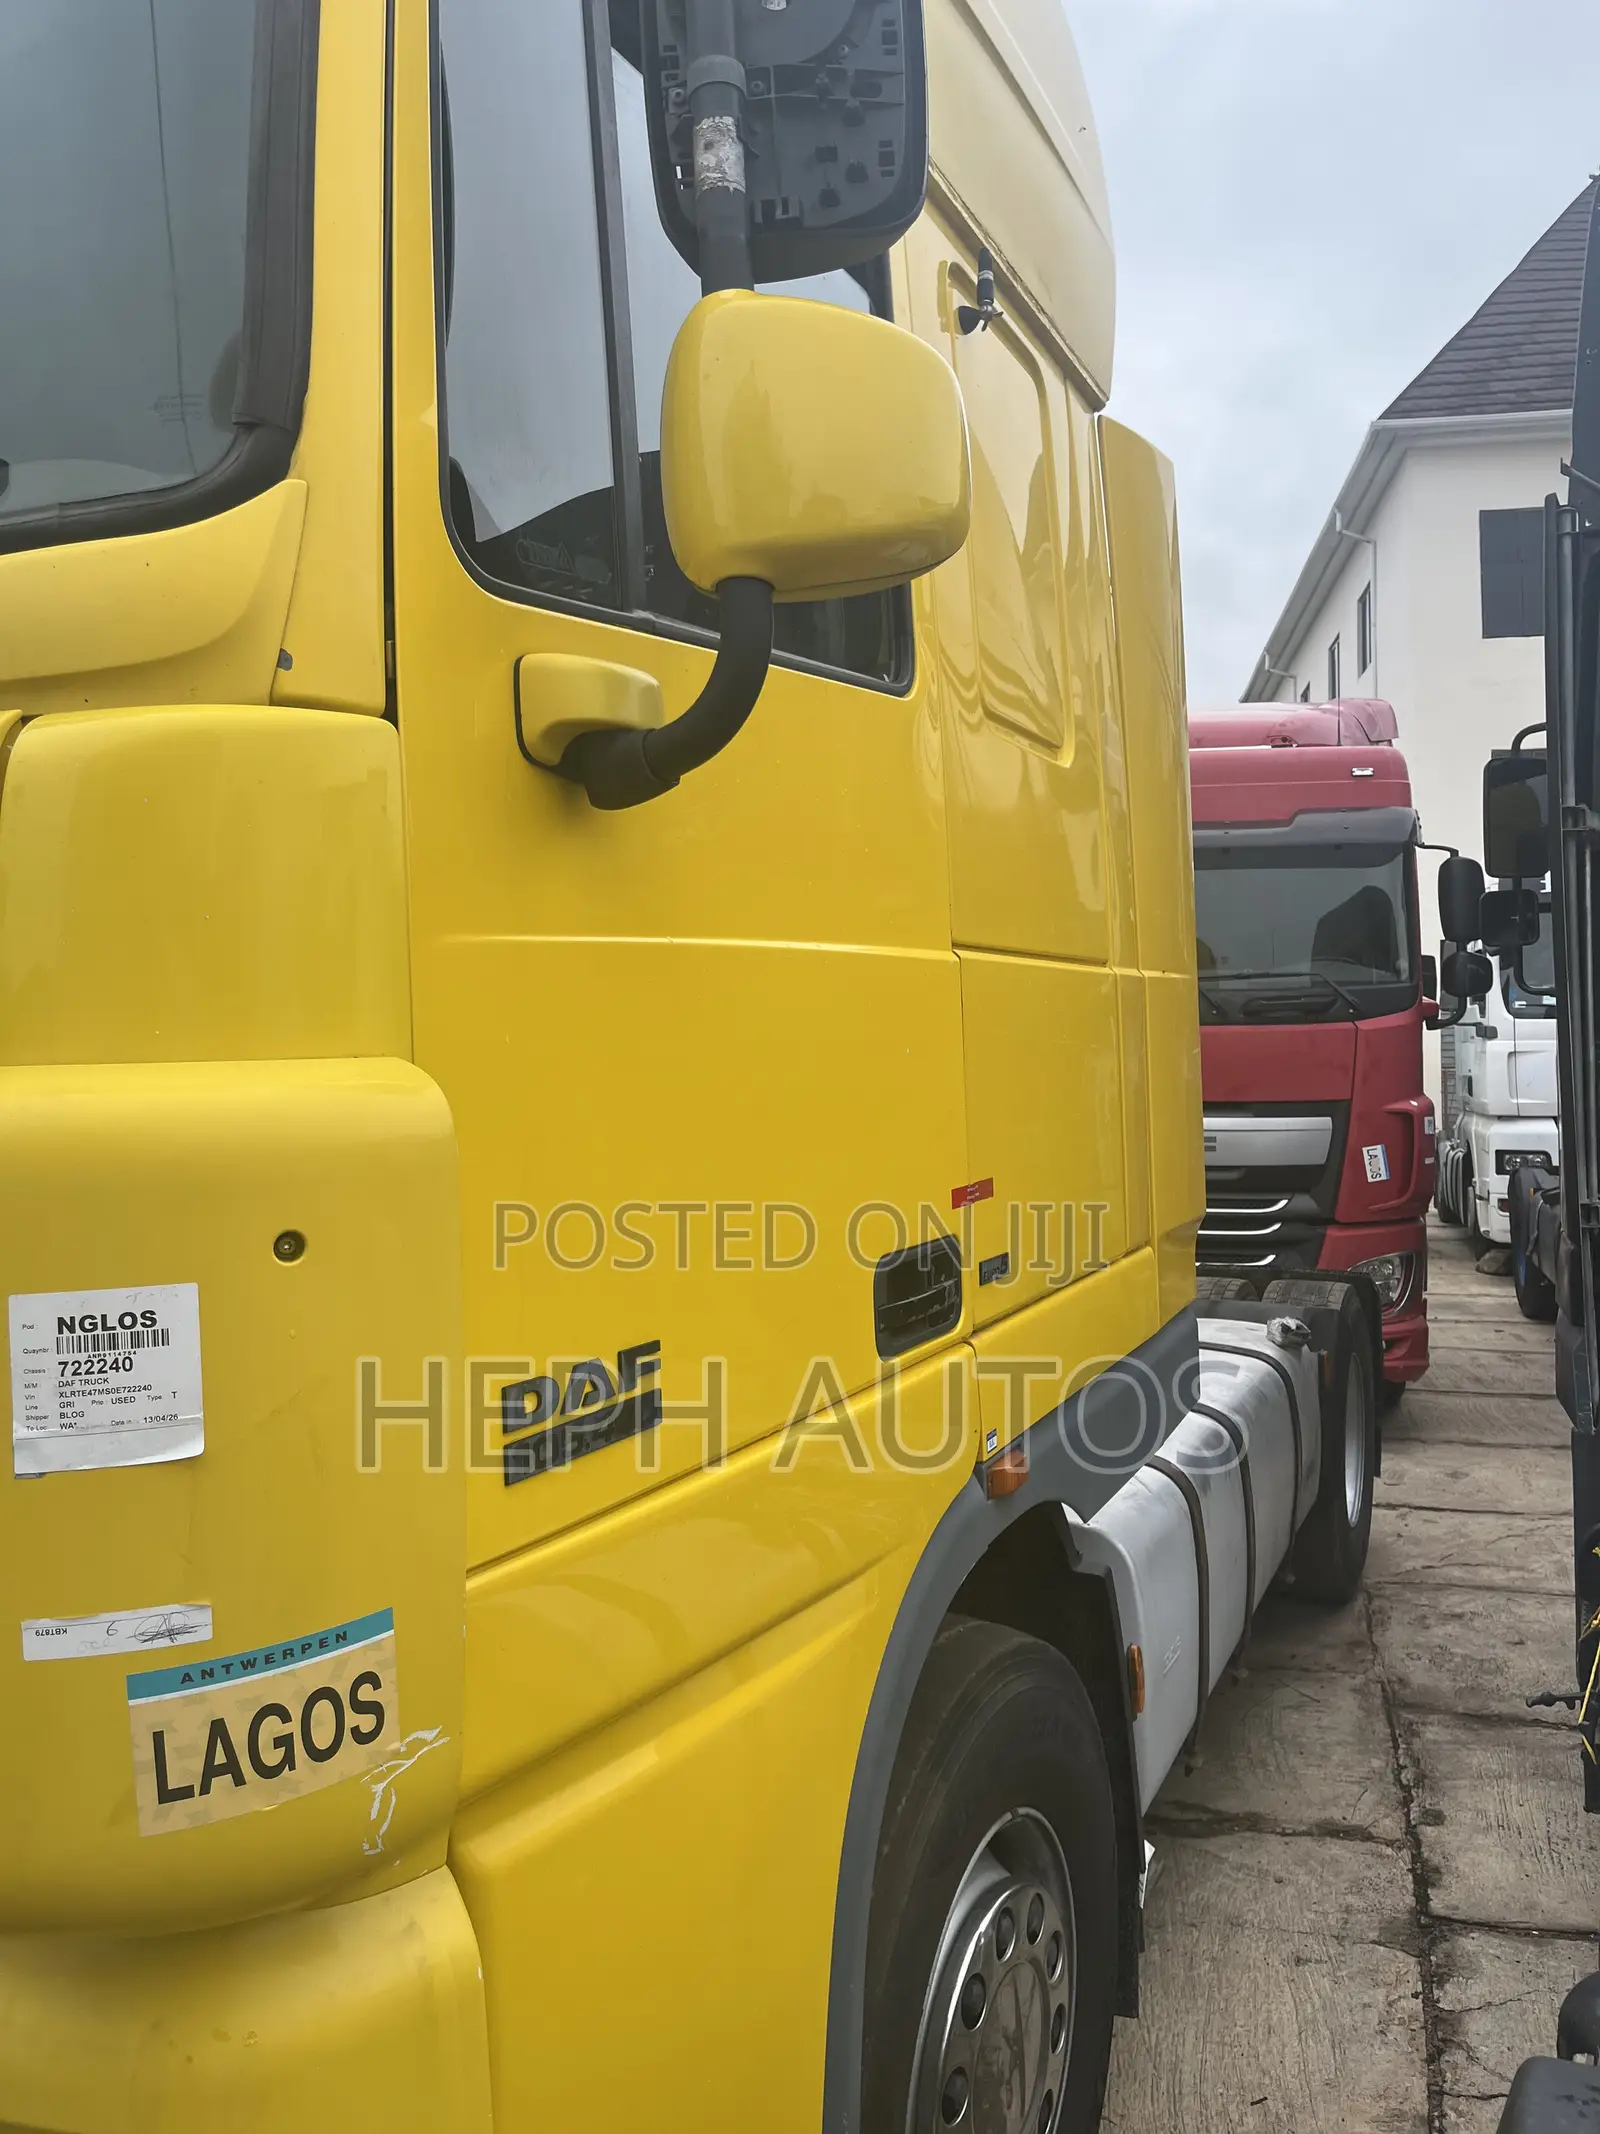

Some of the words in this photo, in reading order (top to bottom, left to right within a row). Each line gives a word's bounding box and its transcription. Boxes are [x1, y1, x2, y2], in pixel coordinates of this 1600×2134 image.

[56, 1309, 158, 1335] NGLOS
[57, 1356, 134, 1378] 722240
[58, 1379, 77, 1388] DAF
[78, 1377, 110, 1387] TRUCK
[501, 1339, 662, 1434] DAF
[59, 1400, 75, 1409] GRI
[110, 1396, 136, 1405] USED
[146, 1394, 163, 1402] Type
[171, 1391, 178, 1399] T
[25, 1414, 50, 1422] Shipper
[59, 1410, 85, 1420] BLOG
[143, 1413, 179, 1424] 13/04/26
[35, 1627, 68, 1637] KBT879
[180, 1629, 349, 1685] ANTWERPEN
[151, 1670, 386, 1806] LAGOS
